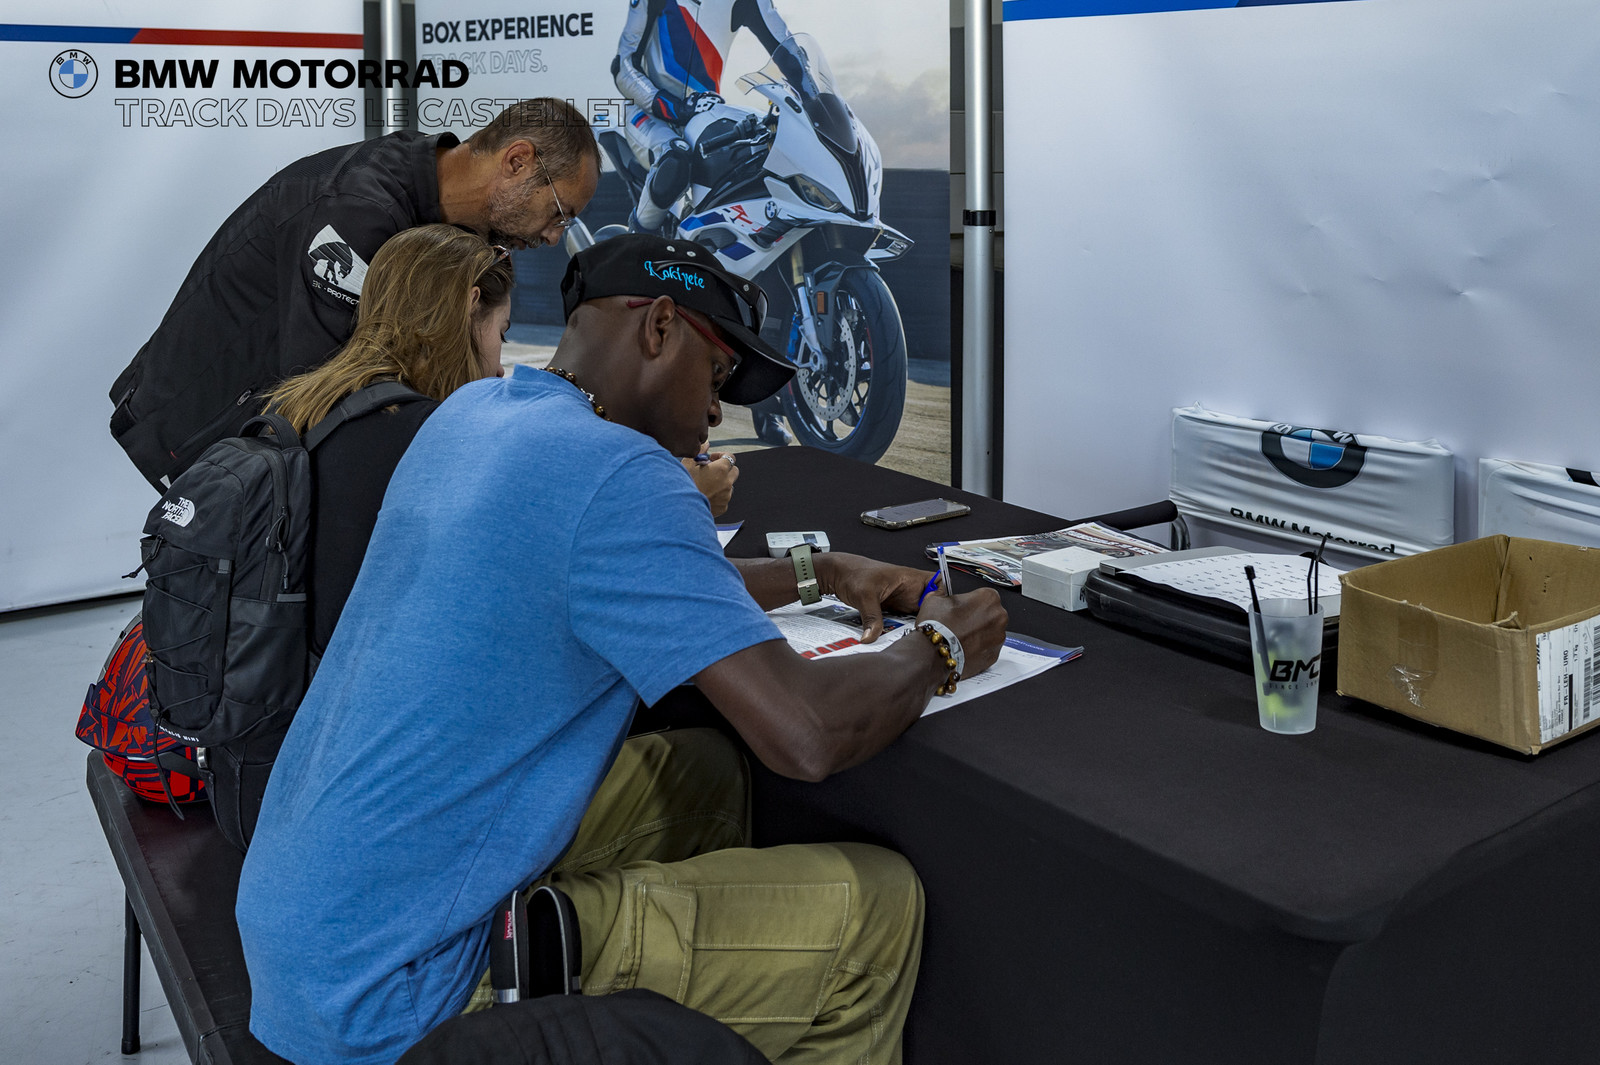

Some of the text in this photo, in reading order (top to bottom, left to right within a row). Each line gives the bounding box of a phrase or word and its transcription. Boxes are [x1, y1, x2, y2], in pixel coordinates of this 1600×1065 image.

[422, 12, 594, 44] BOX EXPERIENCE
[490, 49, 549, 75] DAYS.
